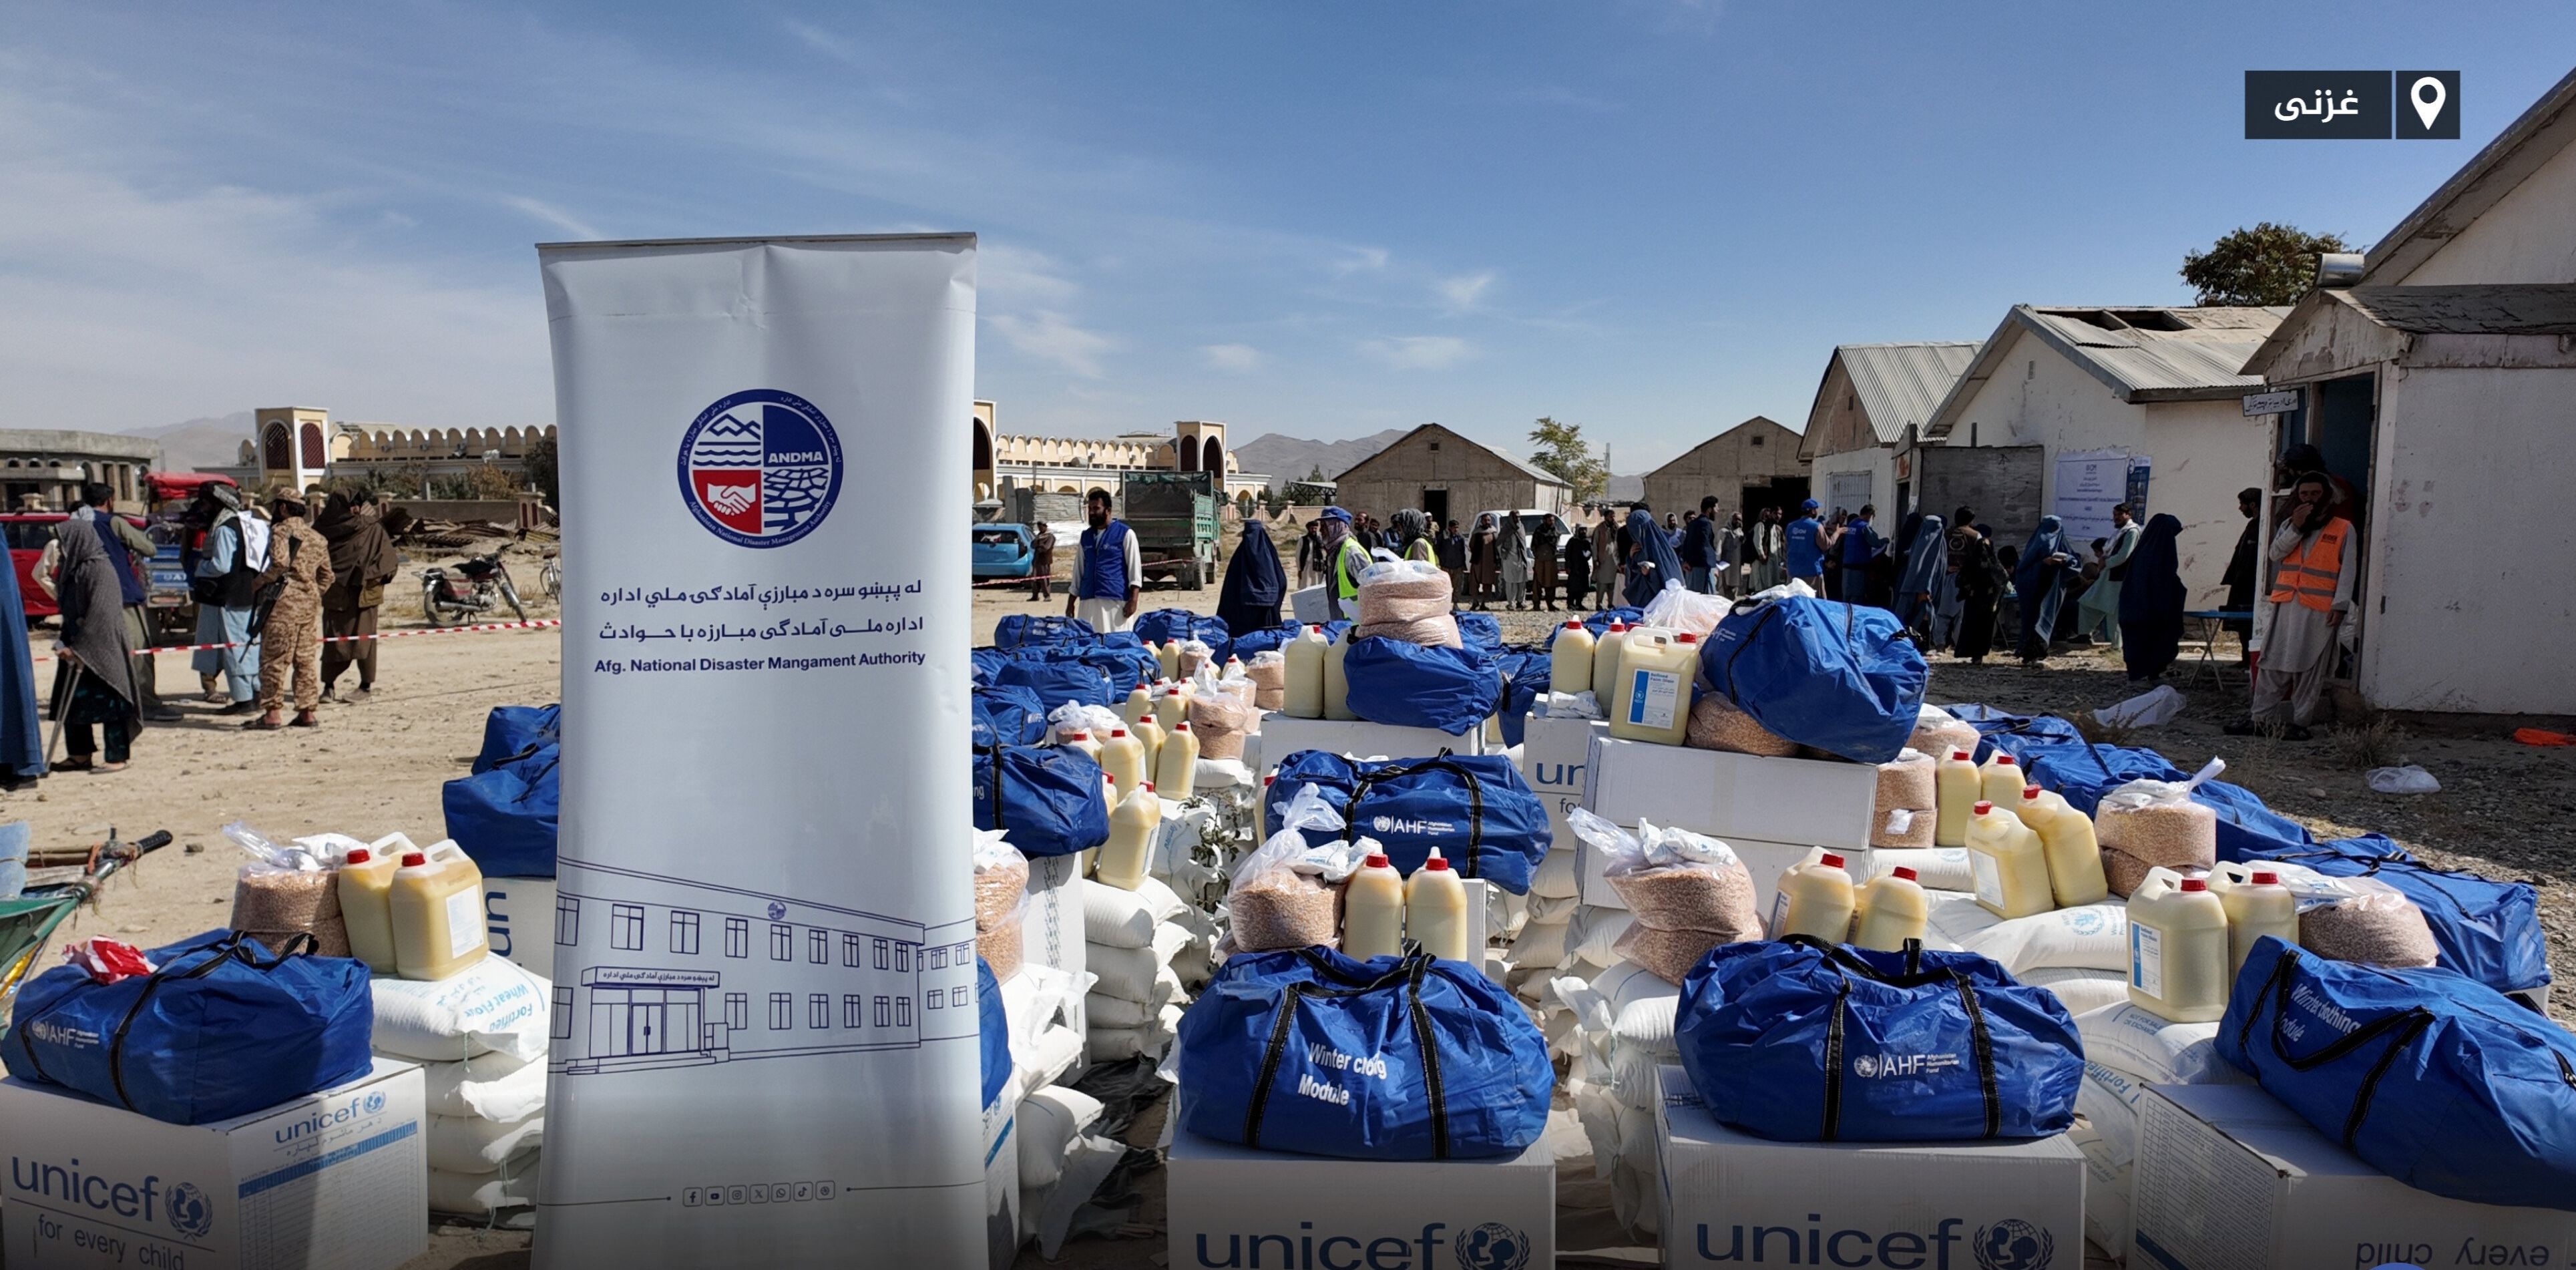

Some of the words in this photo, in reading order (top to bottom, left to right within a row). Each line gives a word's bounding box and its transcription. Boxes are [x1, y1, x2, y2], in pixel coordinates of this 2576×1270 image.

[768, 451, 824, 463] ANDMA
[689, 500, 716, 534] Afghanistan
[716, 526, 743, 543] National
[744, 538, 771, 546] Disaster
[771, 524, 811, 545] Management
[809, 499, 832, 528] Authority
[600, 587, 641, 606] اداره
[812, 588, 822, 598] د
[824, 586, 855, 602] سره
[904, 580, 921, 594] له
[680, 624, 694, 642] با
[760, 618, 829, 640] آمادگی
[885, 616, 923, 635] اداره
[594, 659, 626, 675] Afg.
[630, 658, 696, 672] National
[700, 657, 765, 671] Disaster
[768, 654, 856, 671] Mangament
[858, 650, 926, 666] Authority
[1393, 818, 1428, 834] AHF
[493, 983, 529, 1006] Wheat
[2290, 983, 2321, 1015] Winter
[49, 1024, 76, 1046] AHF
[2279, 1011, 2306, 1042] odule
[1309, 1042, 1352, 1070] Winter
[1883, 1054, 1926, 1076] AHF
[1297, 1072, 1349, 1106] Module
[275, 1097, 361, 1144] unicef
[11, 1156, 159, 1222] unicef
[38, 1213, 63, 1241] for
[74, 1229, 126, 1263] every
[138, 1243, 184, 1270] child
[1196, 1221, 1446, 1270] unicef
[1696, 1213, 1963, 1262] unicef
[2355, 1242, 2433, 1270] child
[2454, 1237, 2550, 1266] every
